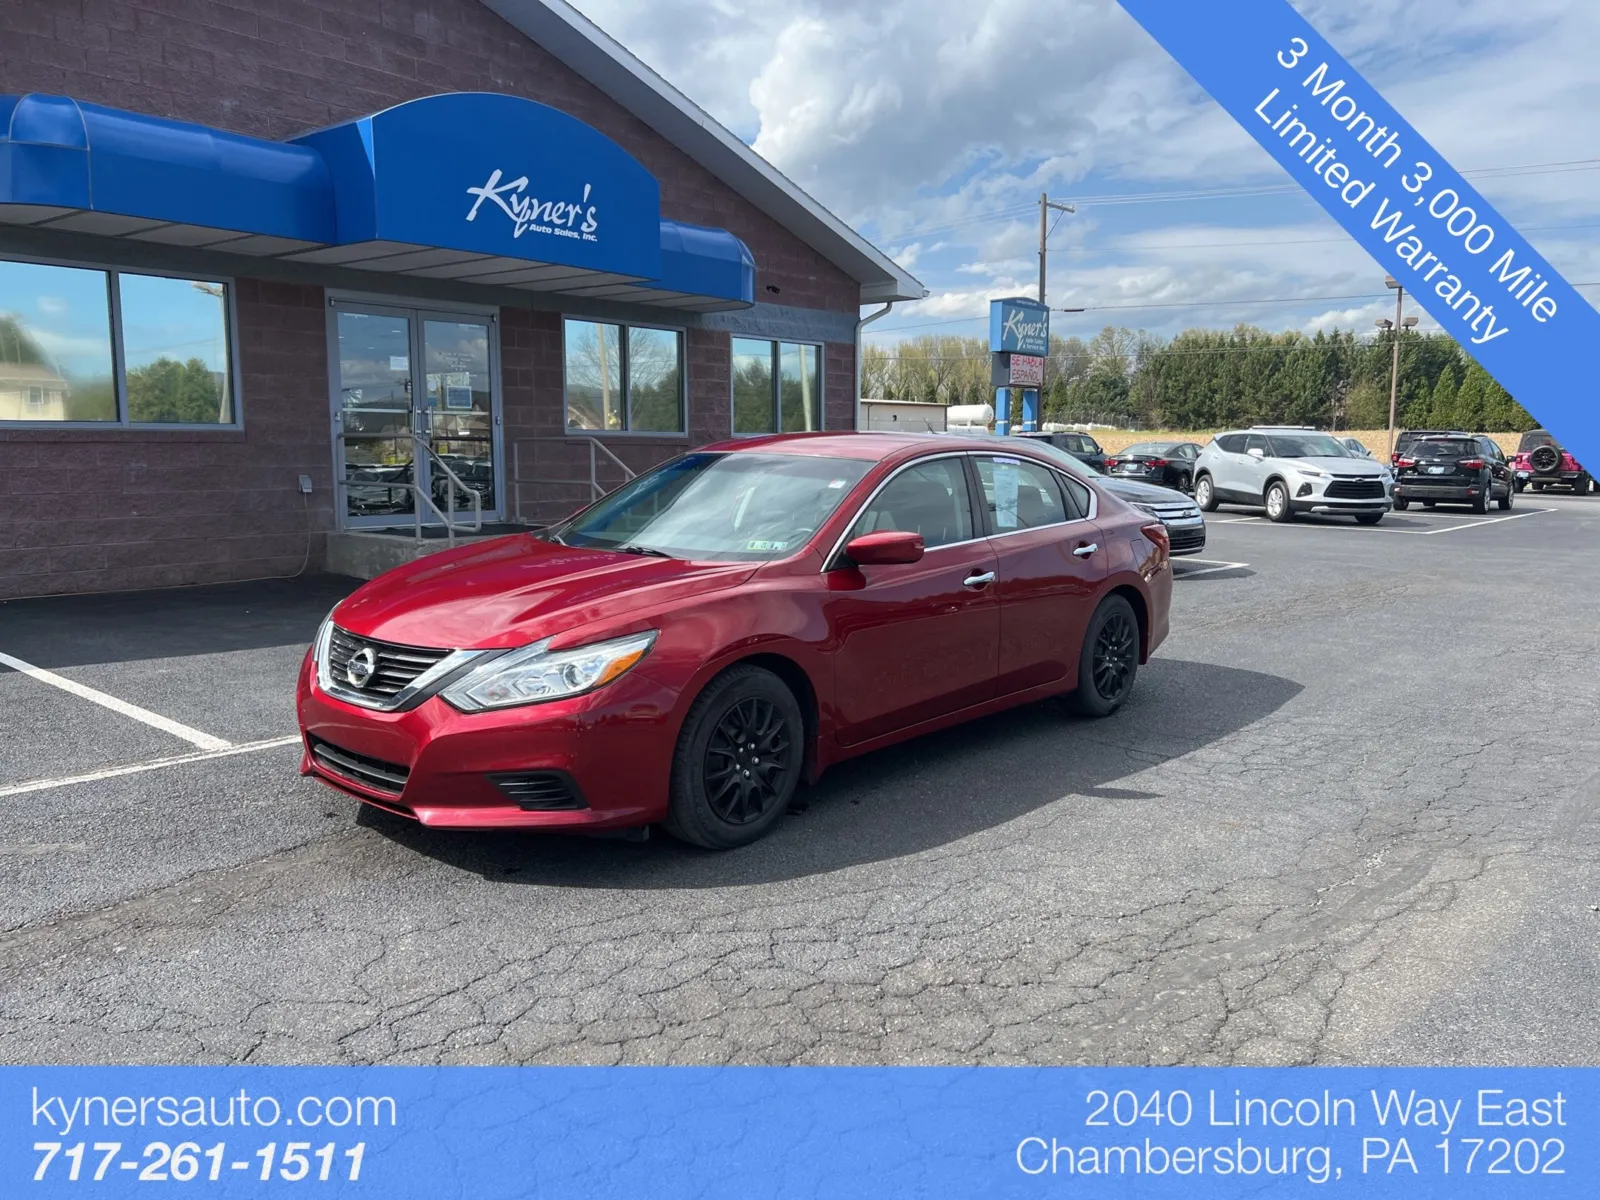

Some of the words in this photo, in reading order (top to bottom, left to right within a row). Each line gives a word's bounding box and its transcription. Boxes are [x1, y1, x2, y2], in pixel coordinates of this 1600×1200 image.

[465, 168, 598, 239] Kyner's
[528, 223, 552, 234] Auto
[553, 227, 581, 240] Sales,
[582, 232, 598, 242] Inc.
[1002, 308, 1048, 351] Kyner's
